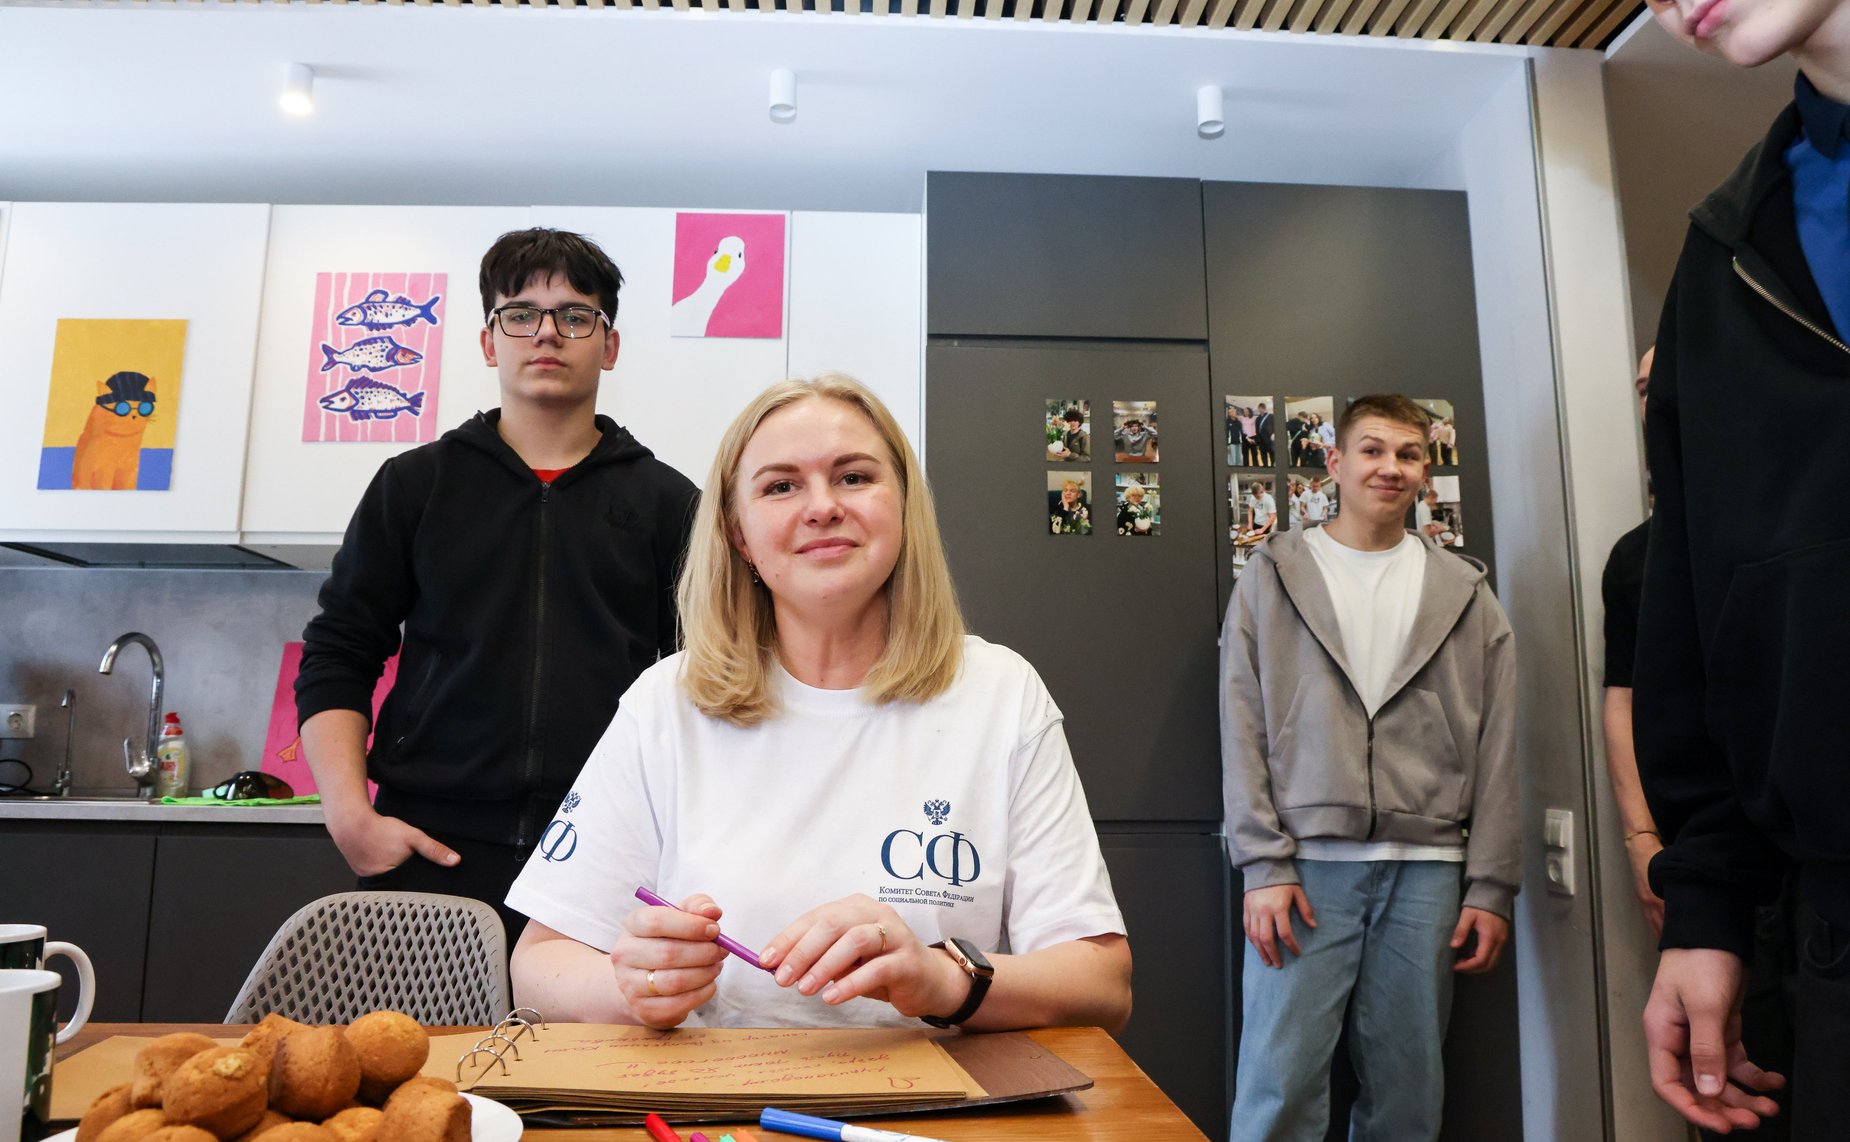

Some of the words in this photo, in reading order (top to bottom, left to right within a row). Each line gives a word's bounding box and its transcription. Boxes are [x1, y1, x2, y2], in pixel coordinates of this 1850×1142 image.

[881, 829, 980, 887] СФ
[879, 886, 914, 896] КОМИТЕТ
[915, 888, 941, 898] СОВЕТА
